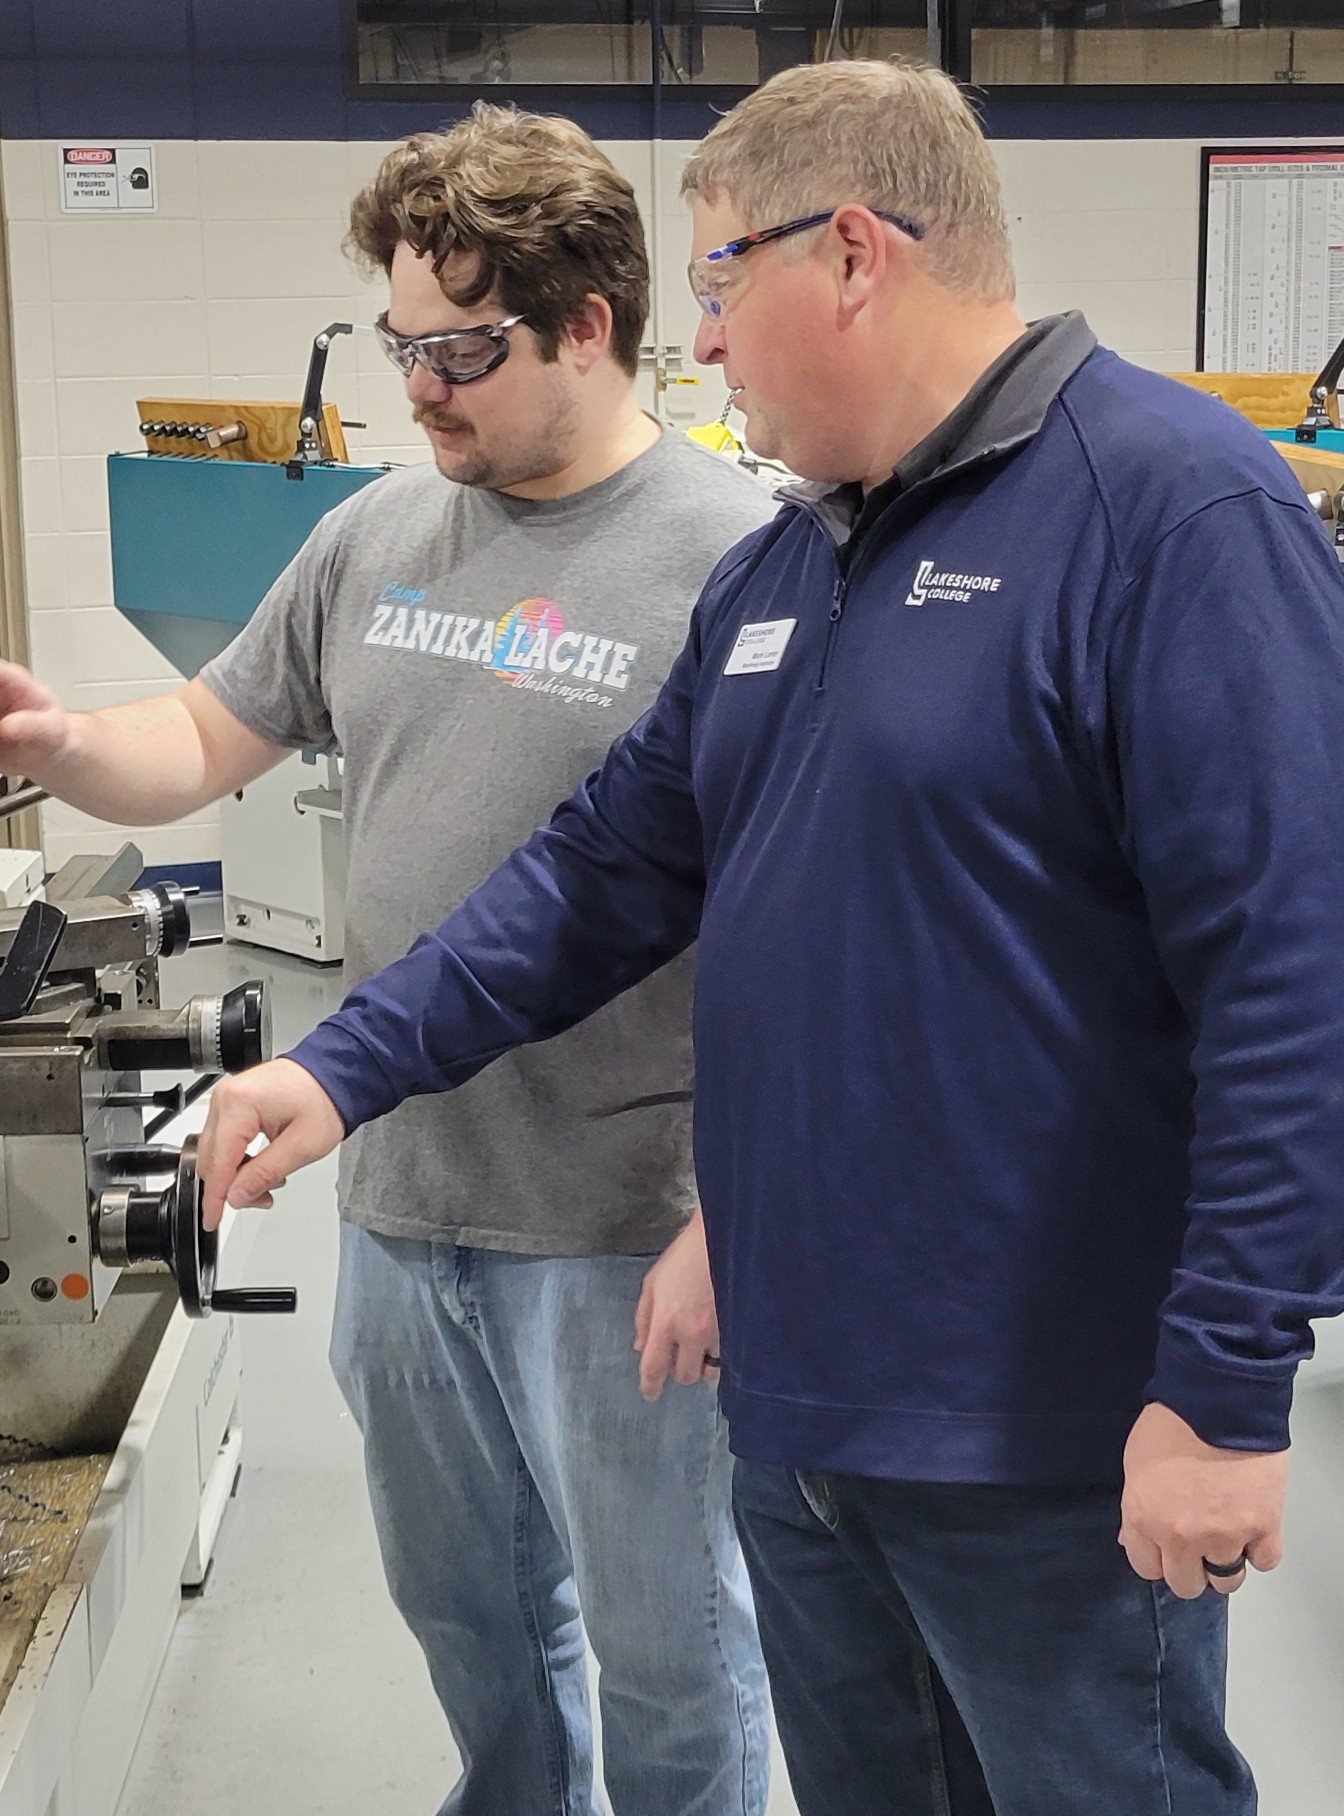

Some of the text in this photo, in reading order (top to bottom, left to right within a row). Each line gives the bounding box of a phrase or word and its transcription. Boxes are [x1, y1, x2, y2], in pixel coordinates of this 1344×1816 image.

[70, 151, 110, 161] DANGER
[925, 572, 1001, 592] LAKESHORE
[378, 581, 426, 606] Camp
[927, 588, 972, 603] COLLEGE
[364, 603, 638, 690] ZANIKA LACHE
[511, 672, 614, 708] Washington
